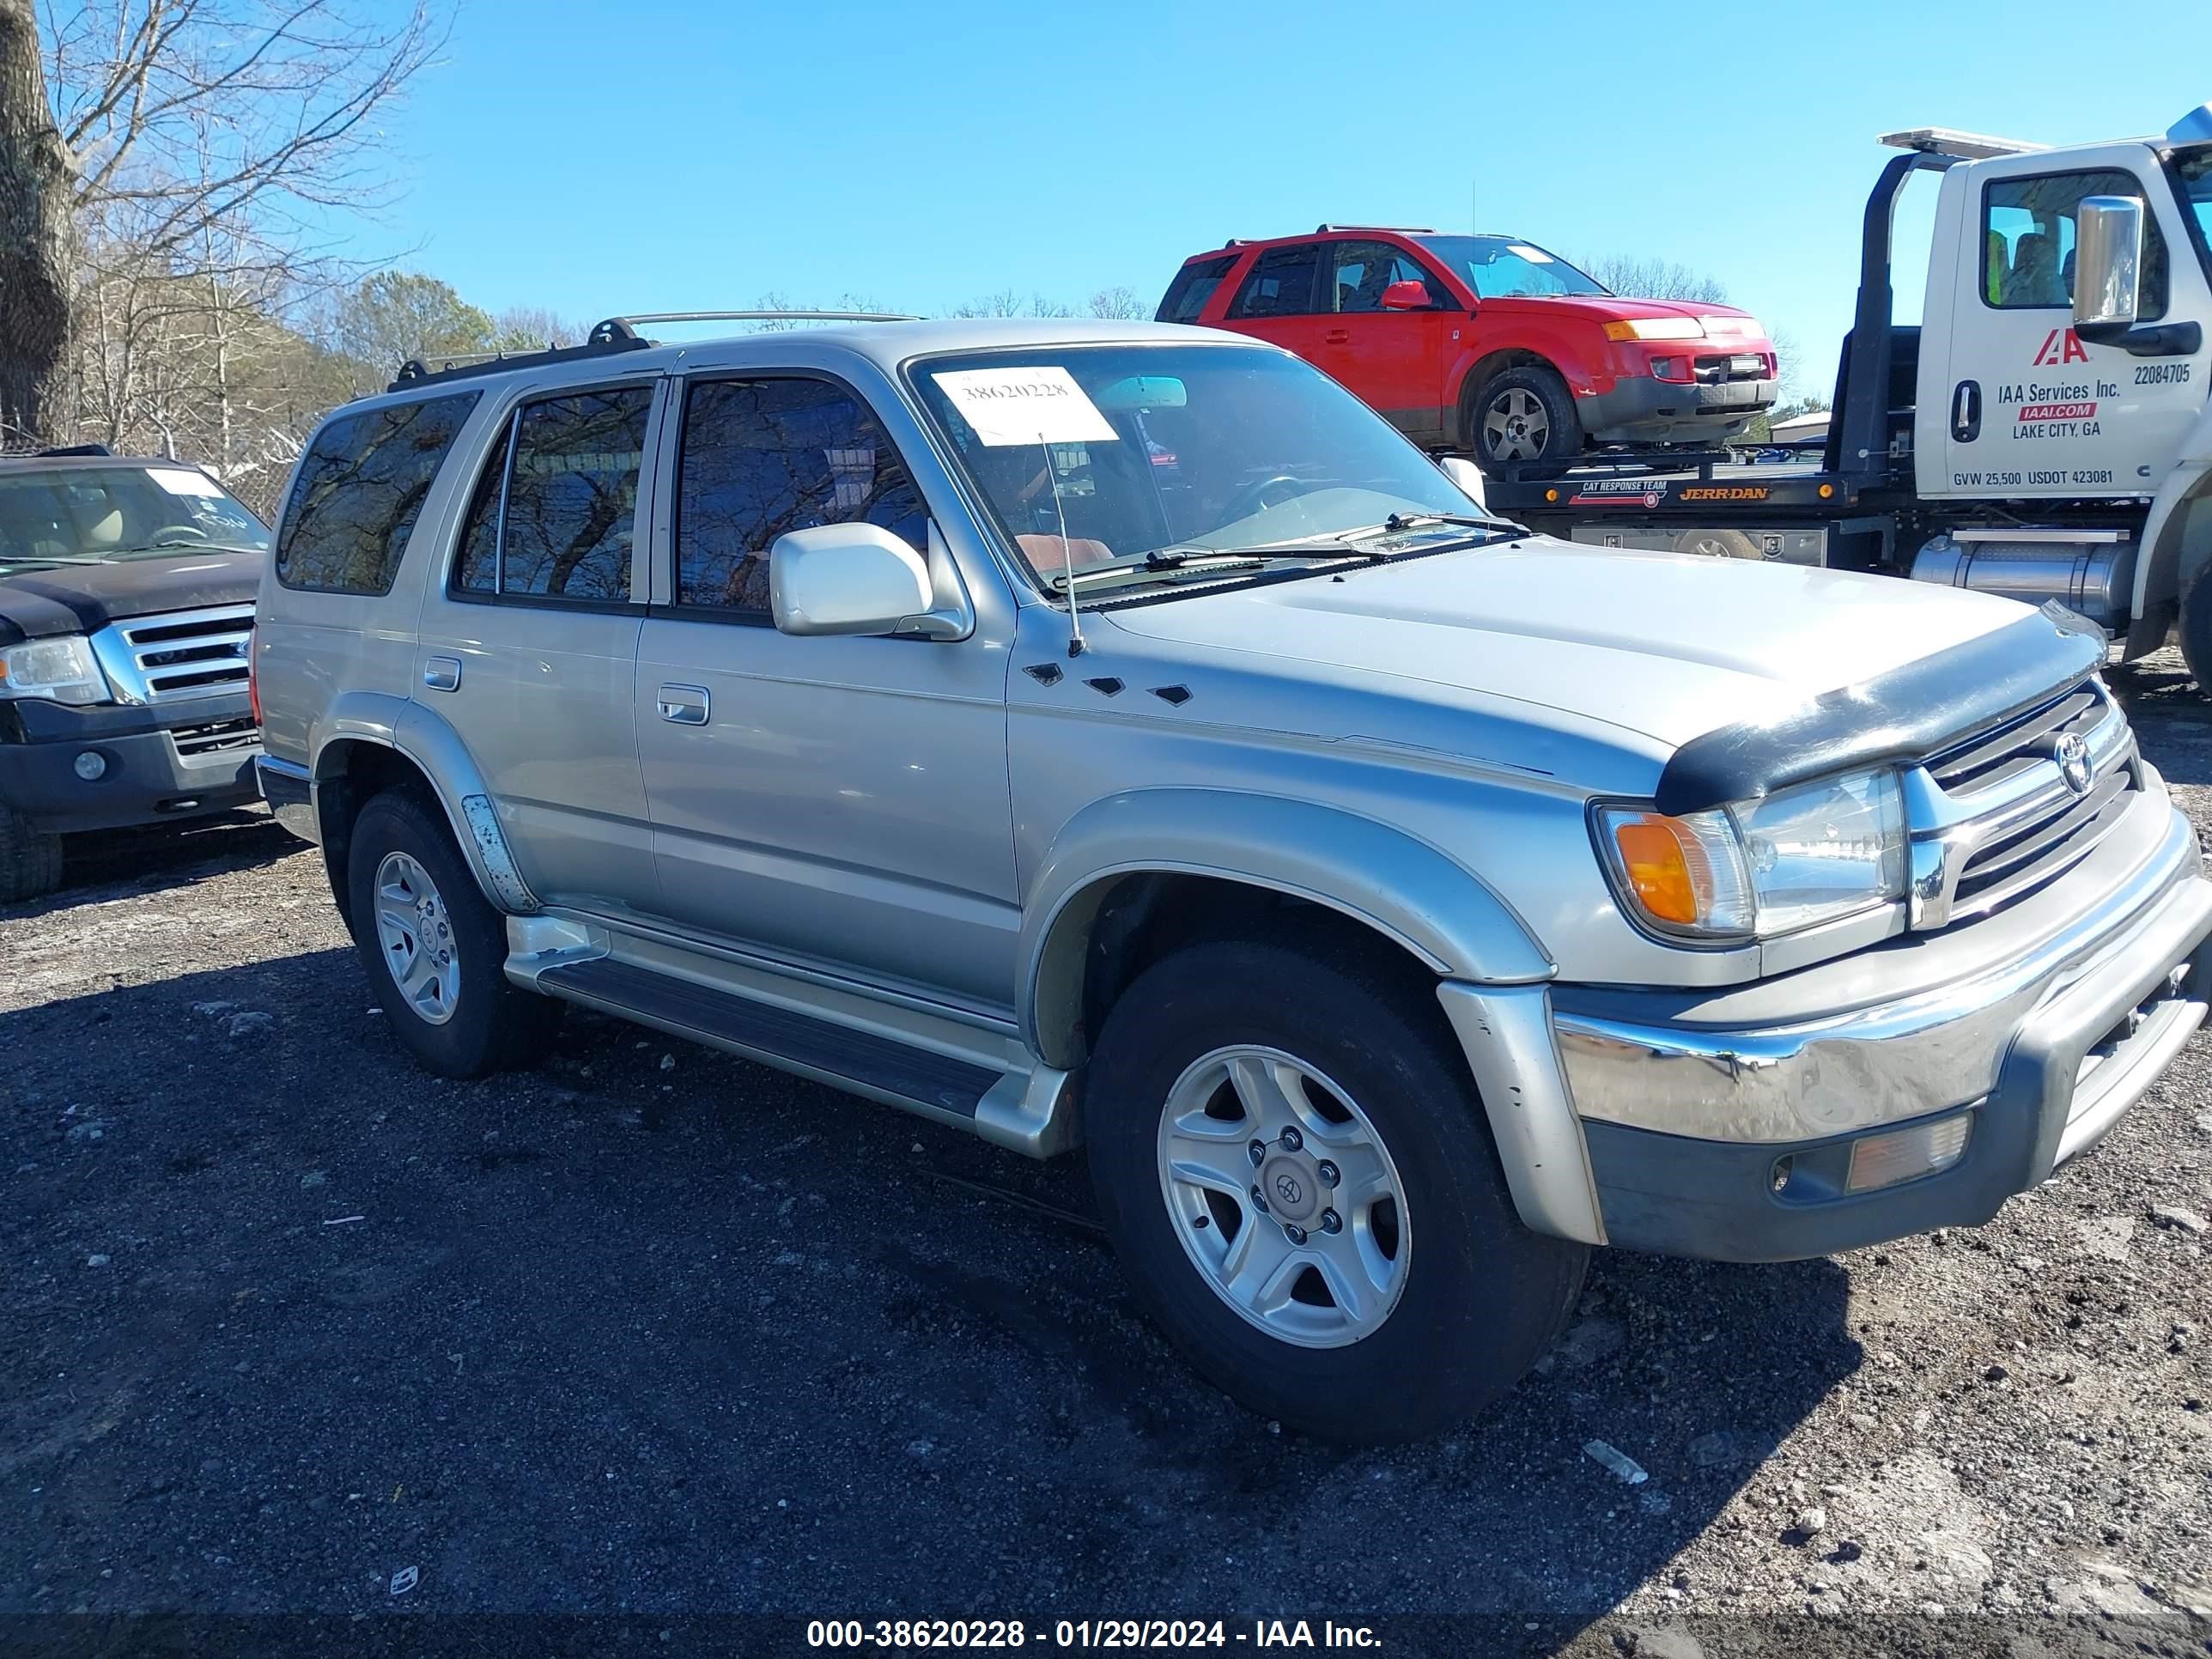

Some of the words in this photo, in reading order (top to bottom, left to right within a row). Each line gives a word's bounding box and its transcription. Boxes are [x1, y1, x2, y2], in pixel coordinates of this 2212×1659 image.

[2135, 364, 2191, 386] 22084705
[962, 384, 1069, 402] 38620228
[1998, 385, 2024, 404] IAA
[2028, 381, 2089, 402] Services
[2096, 379, 2120, 398] Inc.
[2023, 404, 2092, 419] IAAI.COM
[2013, 424, 2045, 440] LAKE
[2049, 422, 2079, 438] CITY,
[2082, 422, 2101, 436] GA
[1583, 482, 1600, 492] CAT
[1600, 481, 1643, 492] RESPONSE
[1644, 480, 1668, 490] TEAM
[1954, 472, 1982, 486] GVW
[1986, 472, 2021, 487] 25,500
[2028, 471, 2068, 484] USDOT
[2072, 471, 2112, 483] 423081
